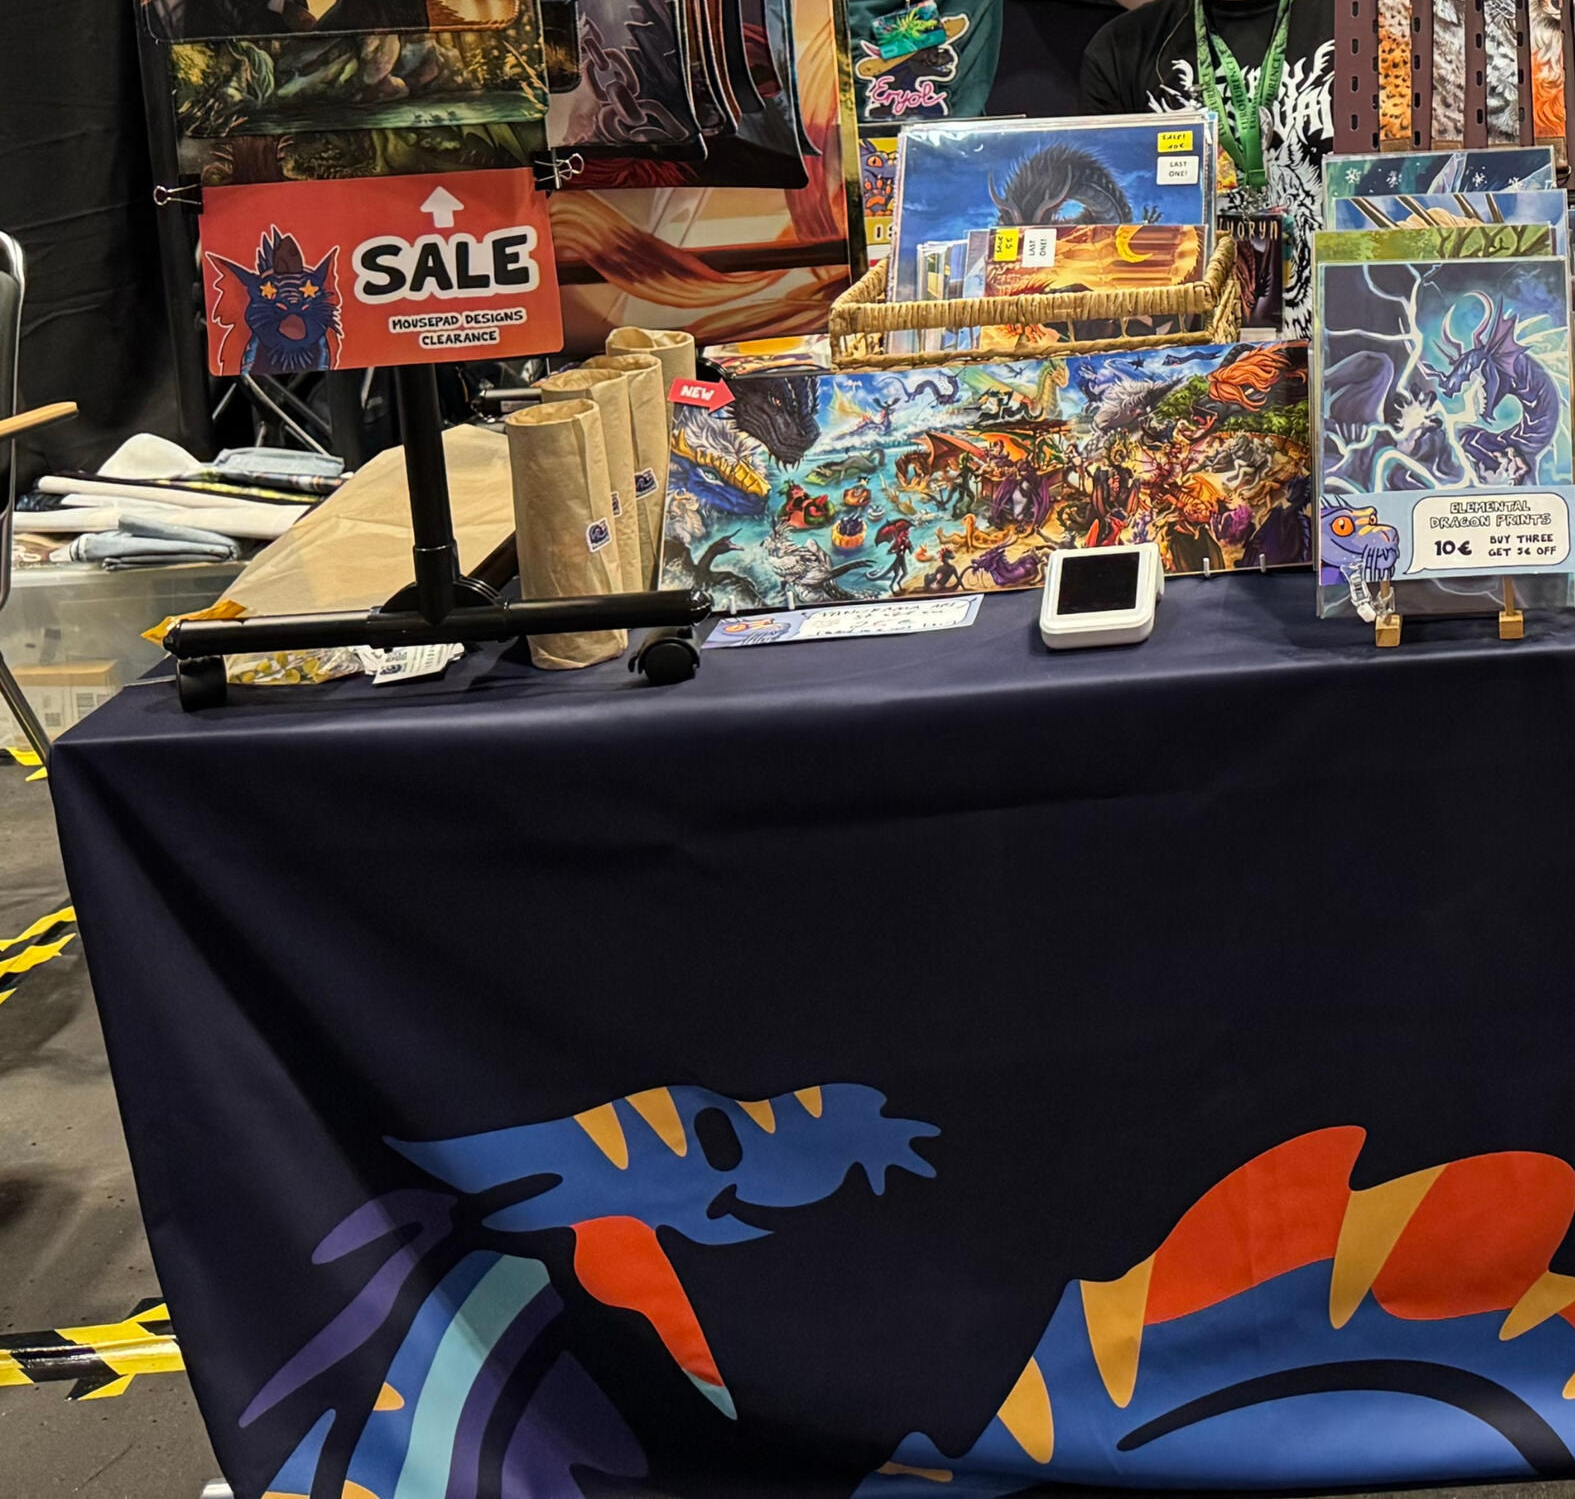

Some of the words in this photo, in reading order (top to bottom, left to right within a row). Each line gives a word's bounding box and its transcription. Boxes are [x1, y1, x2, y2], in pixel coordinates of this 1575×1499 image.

[1028, 240, 1036, 256] LAST
[360, 234, 531, 296] SALE
[391, 314, 459, 331] MOUSEPAD
[465, 309, 524, 325] DESIGNS
[421, 330, 498, 346] CLEARANCE
[681, 385, 715, 402] NEW
[1450, 499, 1531, 514] ELEMENTAL
[1430, 514, 1490, 529] DRAGON
[1496, 512, 1552, 528] PRINTS
[1490, 535, 1511, 544] BUY
[1517, 533, 1554, 543] THREE
[1434, 539, 1473, 558] 10€
[1488, 547, 1511, 557] GET
[1536, 546, 1557, 556] OFF
